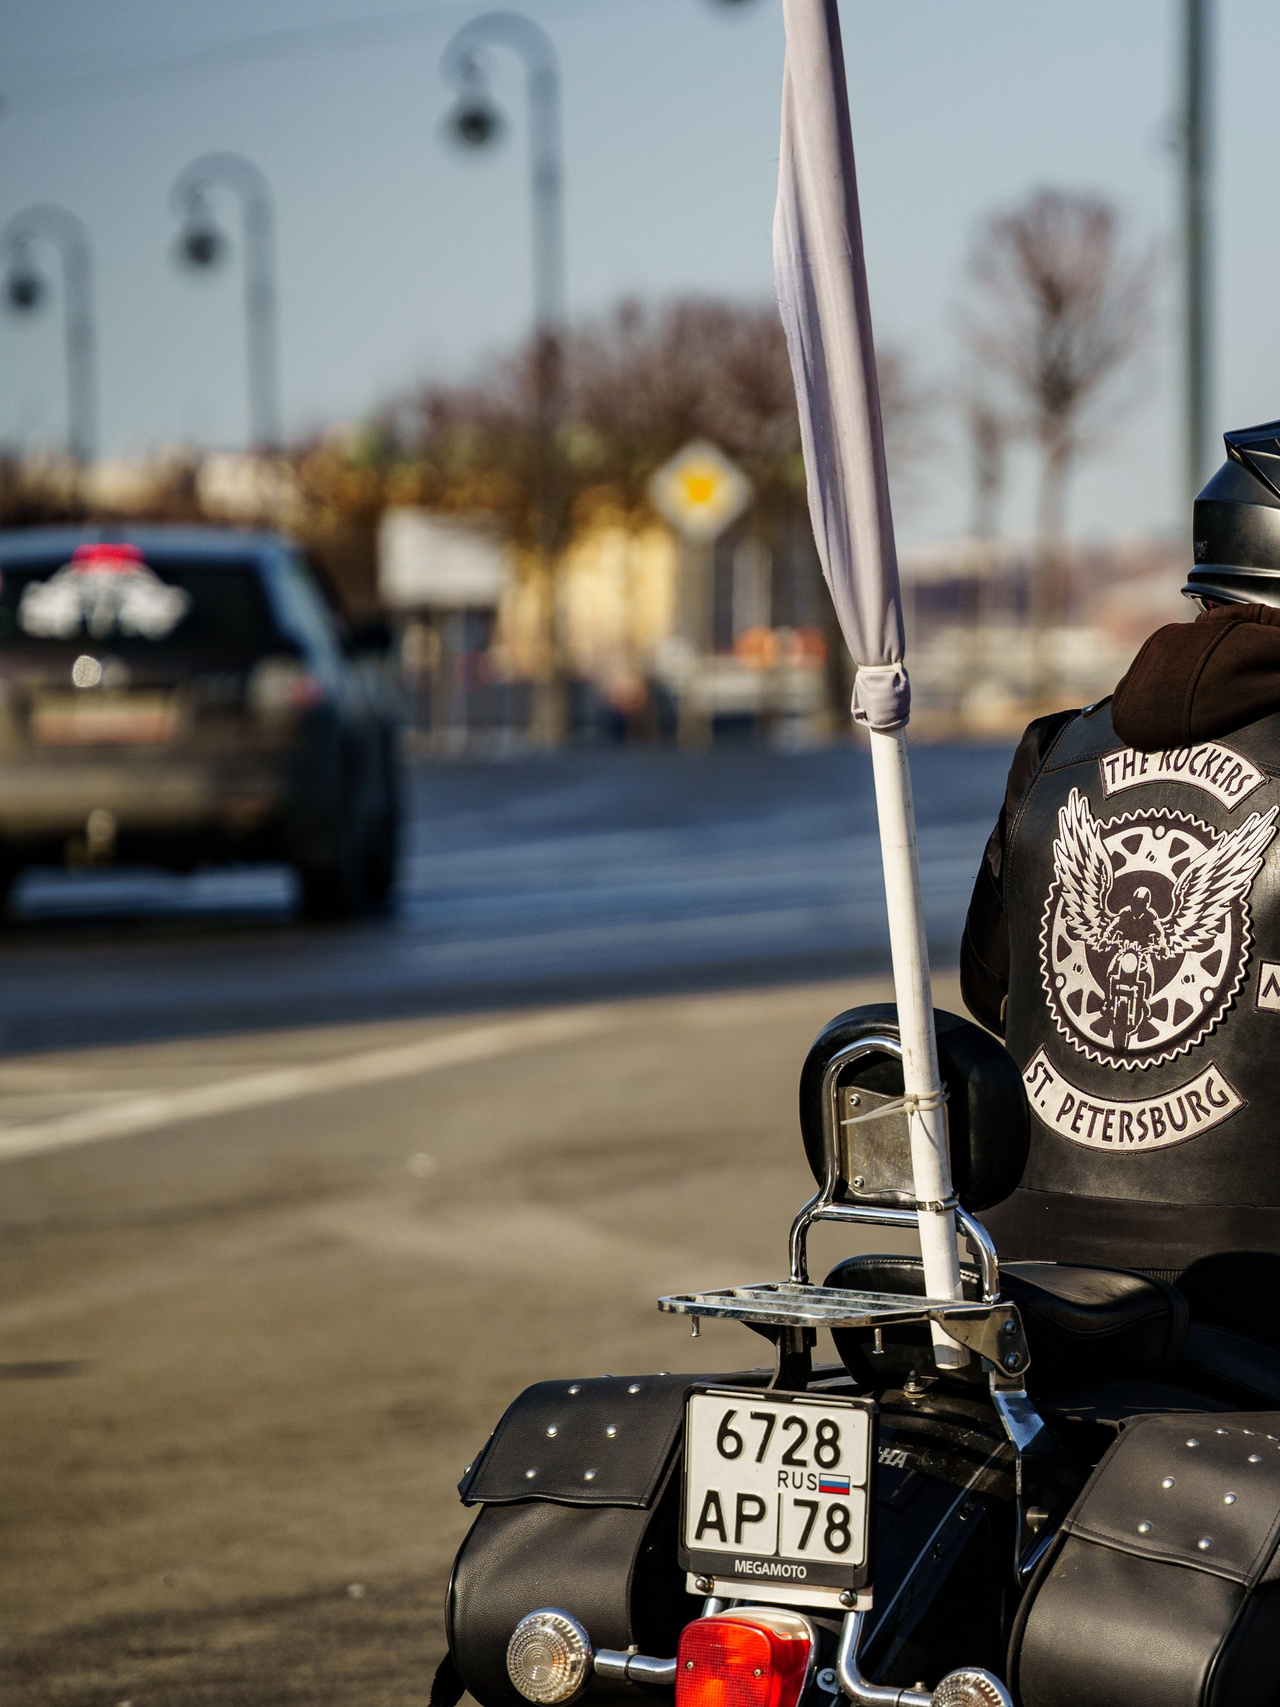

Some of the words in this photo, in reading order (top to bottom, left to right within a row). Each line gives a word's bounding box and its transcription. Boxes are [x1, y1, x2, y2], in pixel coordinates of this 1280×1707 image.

[1106, 750, 1150, 785] THE
[1158, 743, 1254, 797] ROCKERS
[1026, 1061, 1053, 1107] ST.
[1056, 1077, 1230, 1143] PETERSBURG
[716, 1409, 841, 1469] 6728
[878, 1446, 908, 1468] HA
[777, 1470, 817, 1491] RUS
[793, 1497, 851, 1554] 78
[734, 1559, 807, 1578] MEGAMOTO
